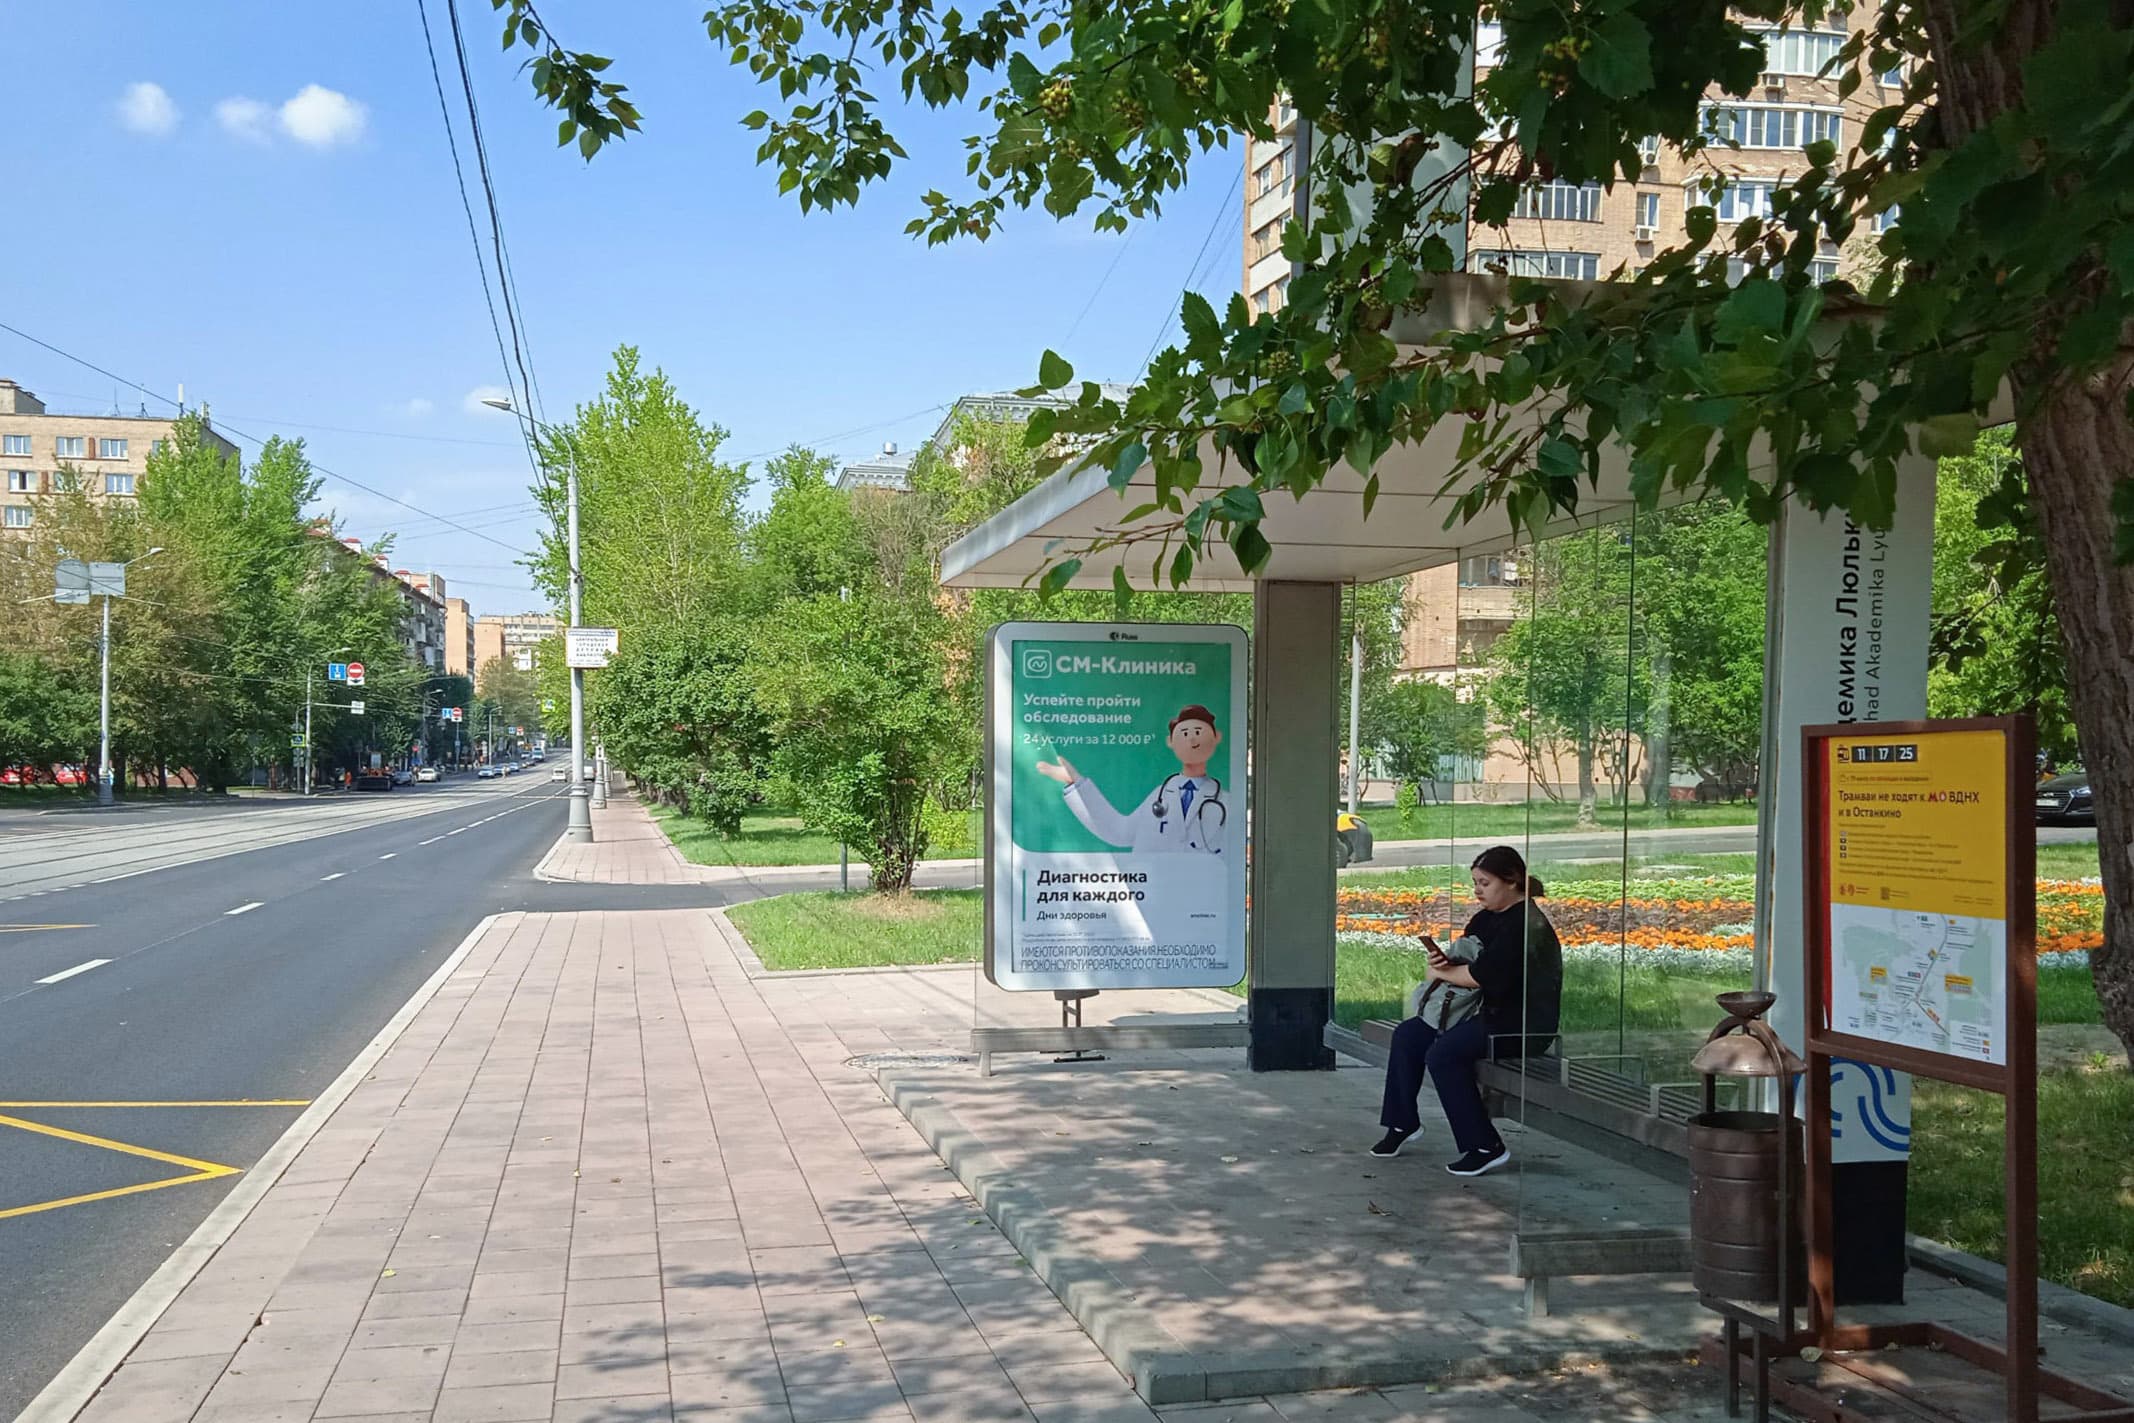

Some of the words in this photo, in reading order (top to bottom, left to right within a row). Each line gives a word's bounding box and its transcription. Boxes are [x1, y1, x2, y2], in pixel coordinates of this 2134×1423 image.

[1836, 512, 1861, 618] Люльк
[1865, 568, 1885, 680] Akademika
[1056, 655, 1197, 674] СМ-Клиника
[1023, 693, 1084, 706] Успейте
[1087, 694, 1141, 709] пройти
[1023, 711, 1132, 725] обследование
[1023, 733, 1039, 744] 24
[1041, 735, 1083, 748] услуги
[1086, 736, 1099, 745] за
[1102, 734, 1116, 744] 12
[1119, 734, 1141, 745] 000
[1858, 748, 1866, 760] 11
[1878, 747, 1889, 760] 17
[1899, 747, 1913, 760] 25
[1878, 792, 1890, 802] не
[1892, 793, 1918, 803] ходят
[1948, 790, 1980, 805] ВДНХ
[1853, 806, 1902, 819] Останкино
[1037, 869, 1148, 886] Диагностика
[1037, 890, 1069, 904] для
[1072, 890, 1145, 904] каждого
[1036, 910, 1058, 921] Дни
[1059, 911, 1107, 922] здоровья
[1021, 945, 1064, 958] ИМЕЮТСЯ
[1157, 944, 1217, 956] НЕОБХОДИМО
[1021, 958, 1131, 971] ПРОКОНСУЛЬТИРОВАТЬСЯ
[1131, 958, 1145, 969] СО
